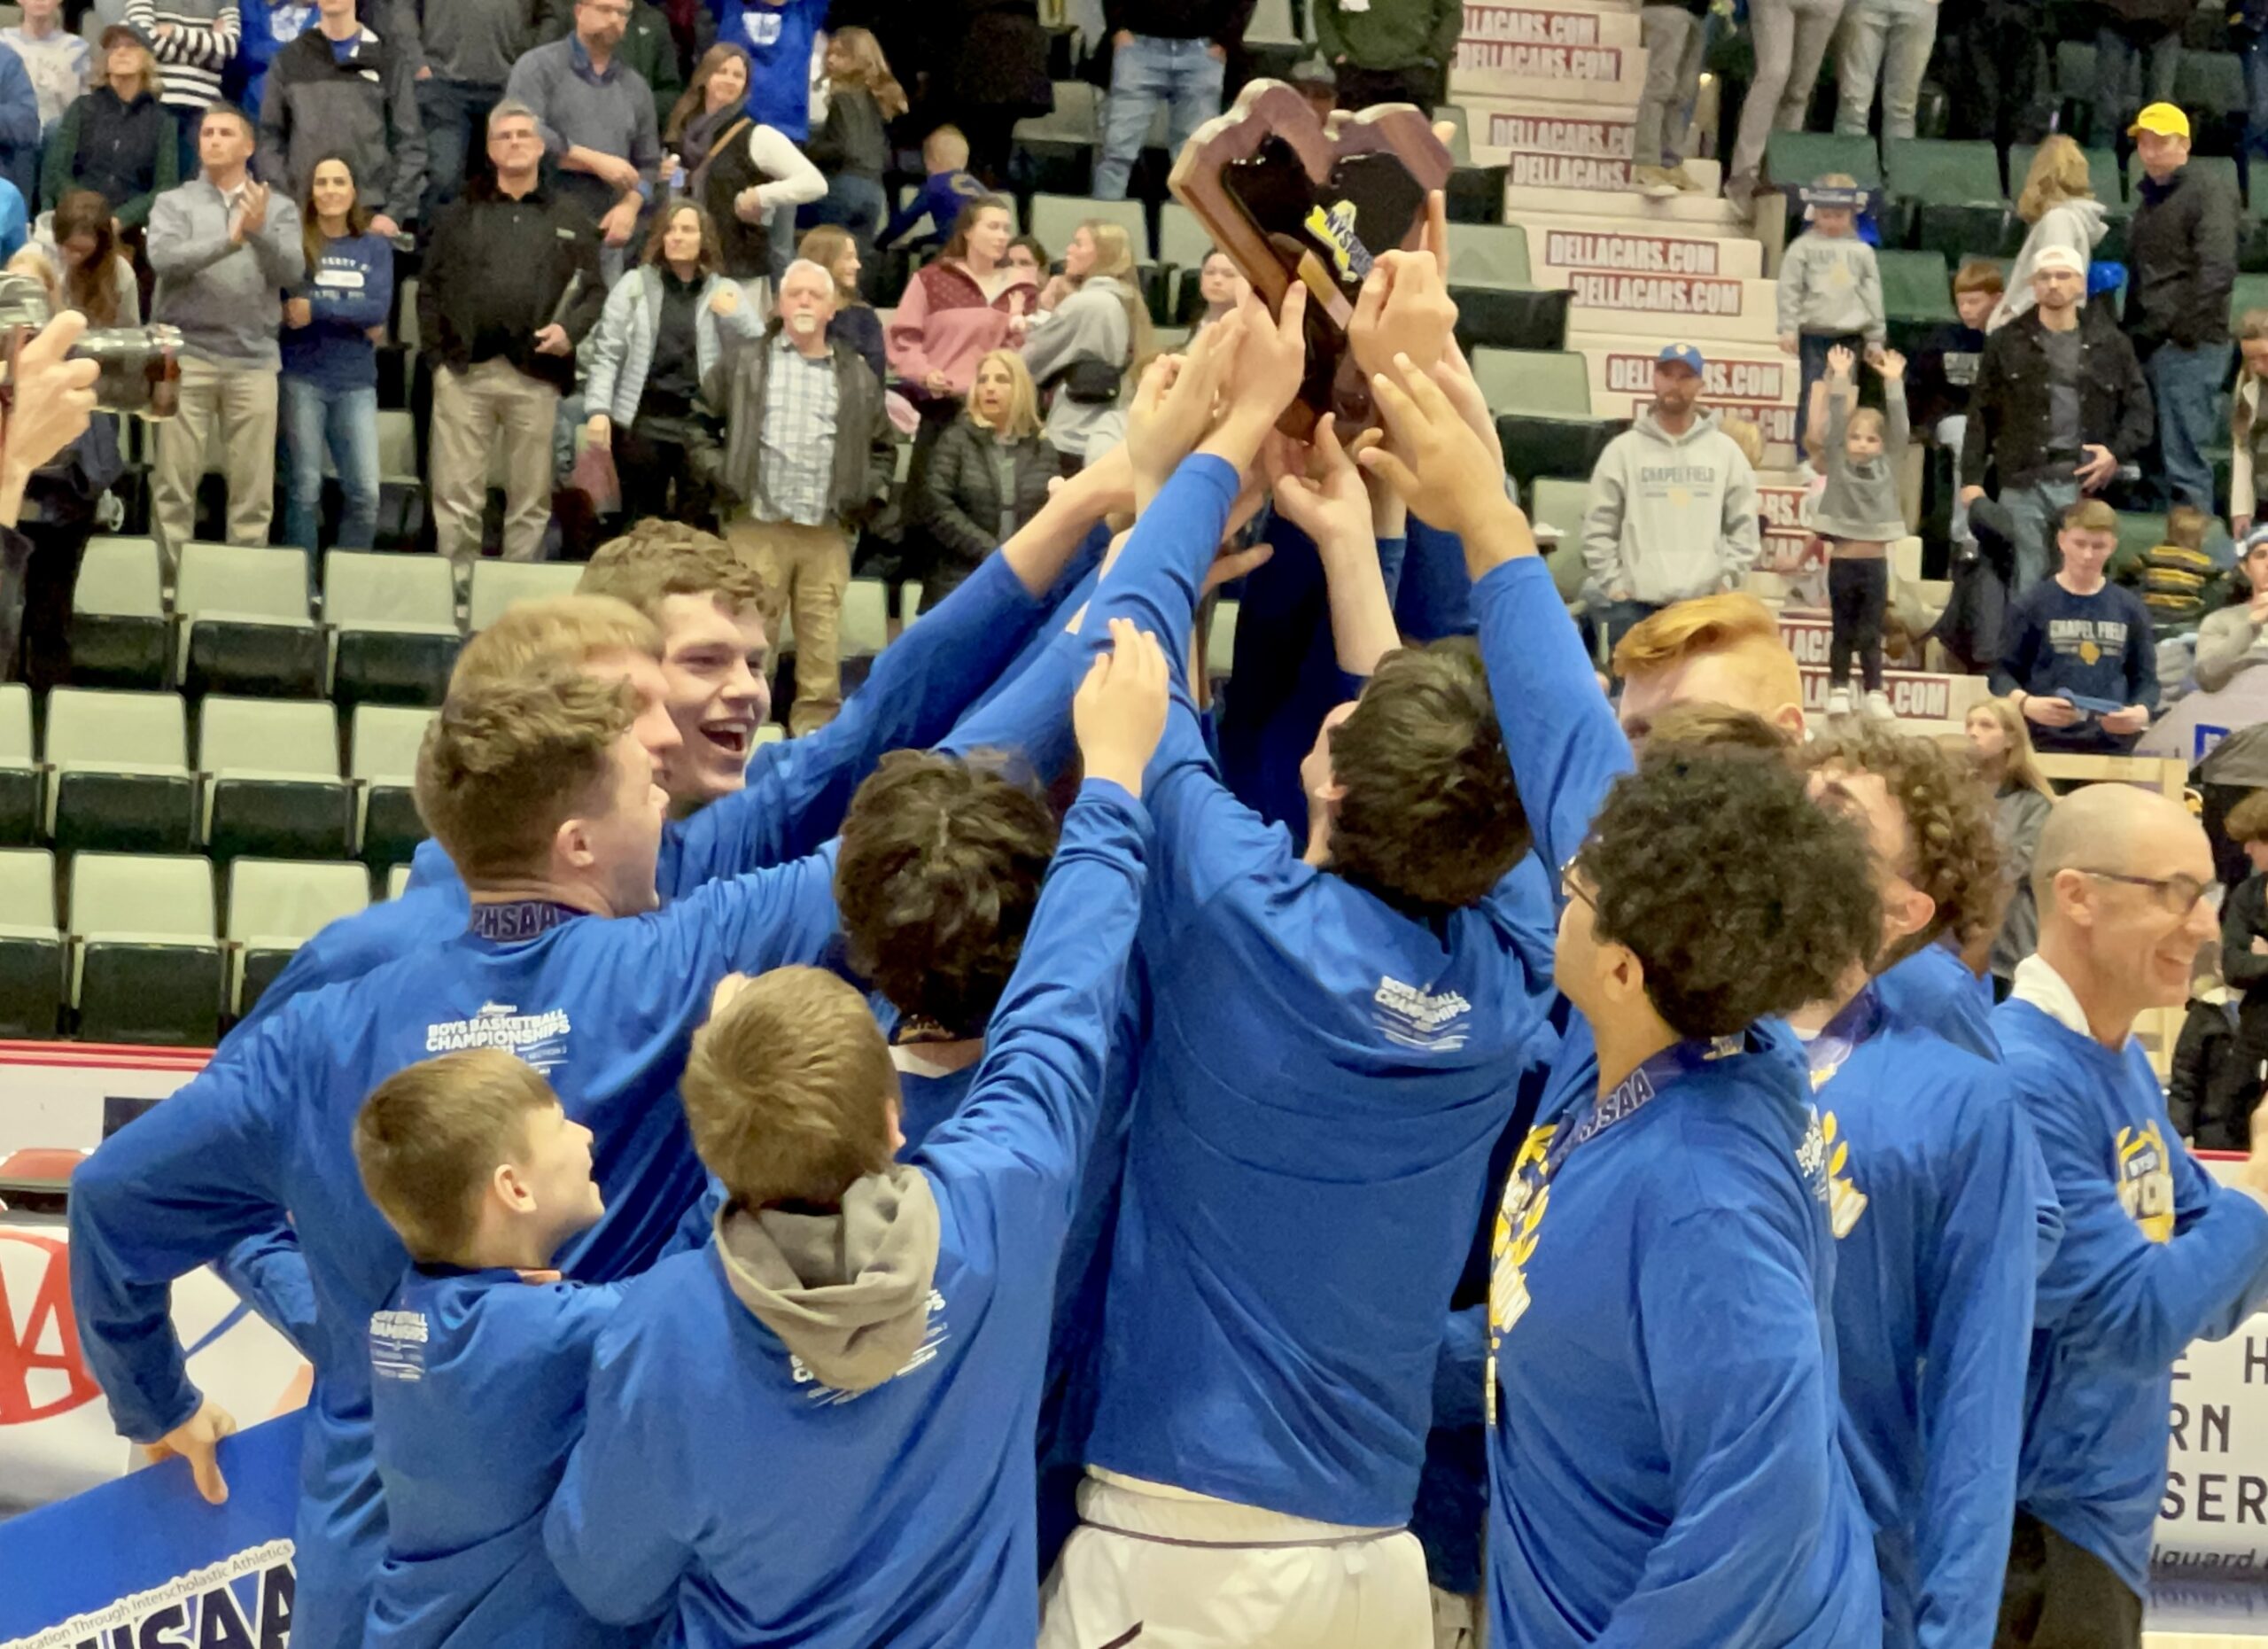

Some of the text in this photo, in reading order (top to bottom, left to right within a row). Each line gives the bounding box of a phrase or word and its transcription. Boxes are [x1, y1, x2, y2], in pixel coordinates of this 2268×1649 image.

[1463, 7, 1596, 43] LLACARS.COM
[1493, 117, 1636, 159] DELLACARS.CO
[1550, 234, 1716, 274] DELLACARS.COM
[1572, 276, 1740, 314] DELLACARS.COM
[425, 1018, 571, 1052] CHAMPIONSHIPS
[428, 1021, 468, 1038] BOYS
[470, 1007, 568, 1032] BASKETBALL
[71, 1602, 130, 1636] Through
[133, 1565, 229, 1612] Interscholastic
[232, 1543, 292, 1573] Athletics
